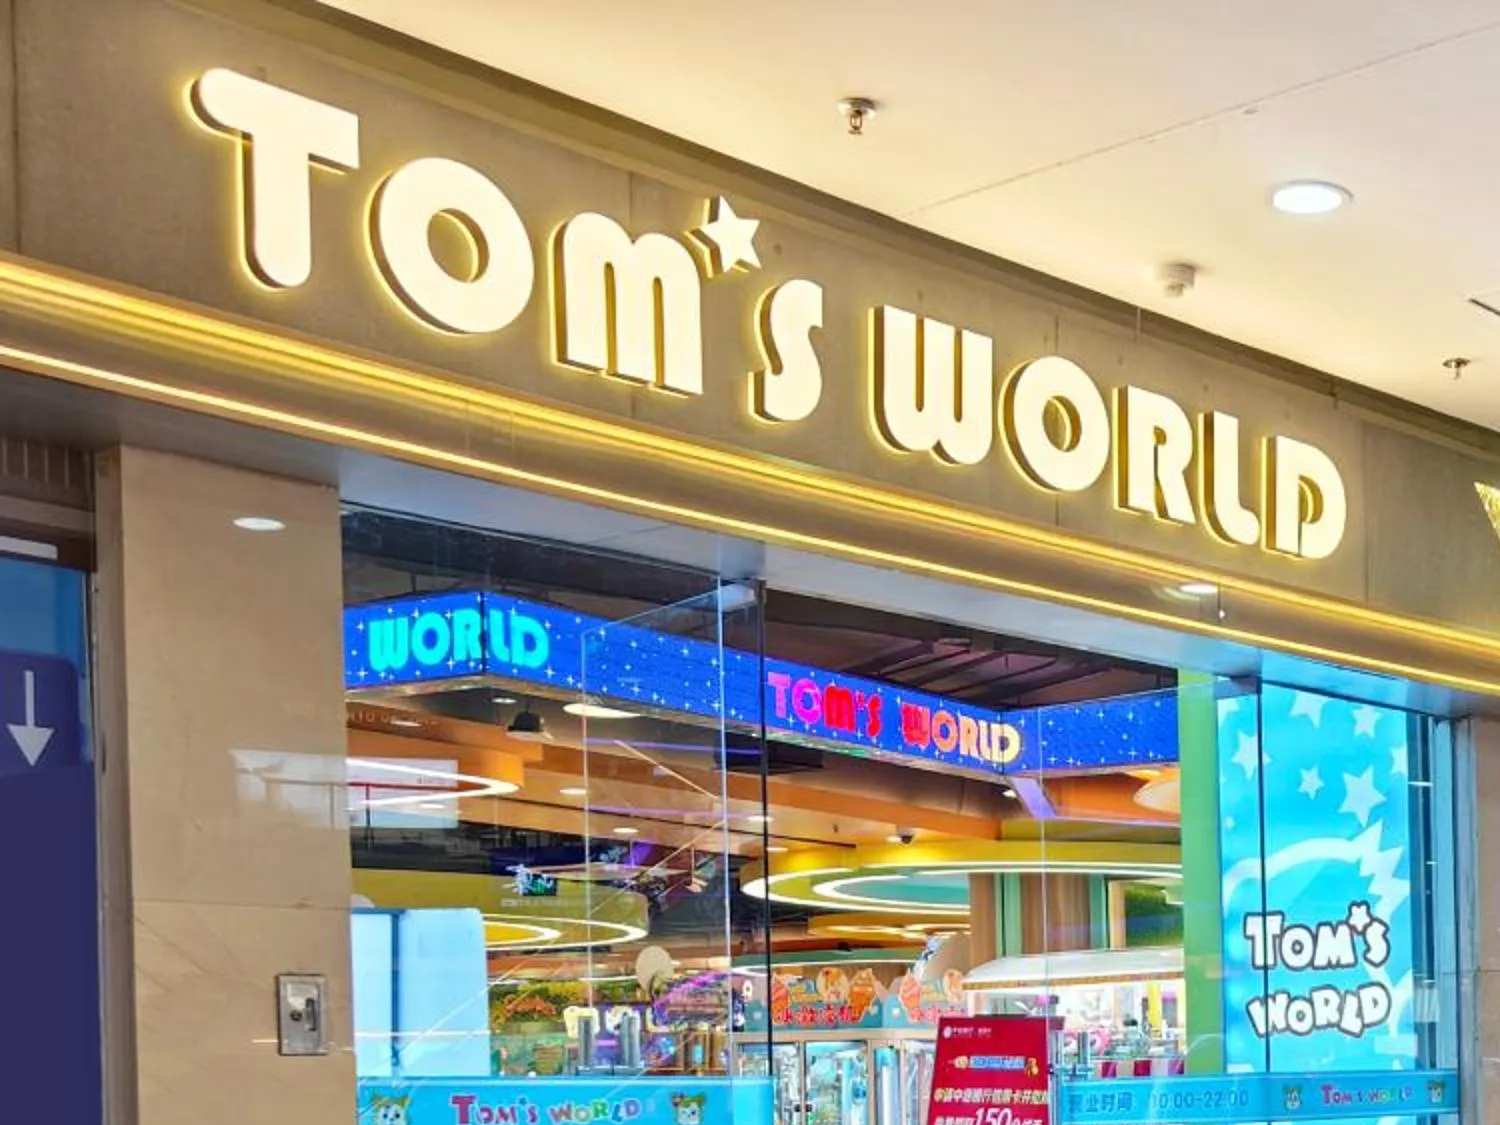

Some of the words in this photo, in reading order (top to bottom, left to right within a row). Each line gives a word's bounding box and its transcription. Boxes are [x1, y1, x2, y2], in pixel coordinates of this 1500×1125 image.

[868, 303, 1347, 560] WORLD
[368, 607, 550, 672] WORLD
[899, 702, 1022, 764] WORLD
[1246, 981, 1392, 1039] WORLD
